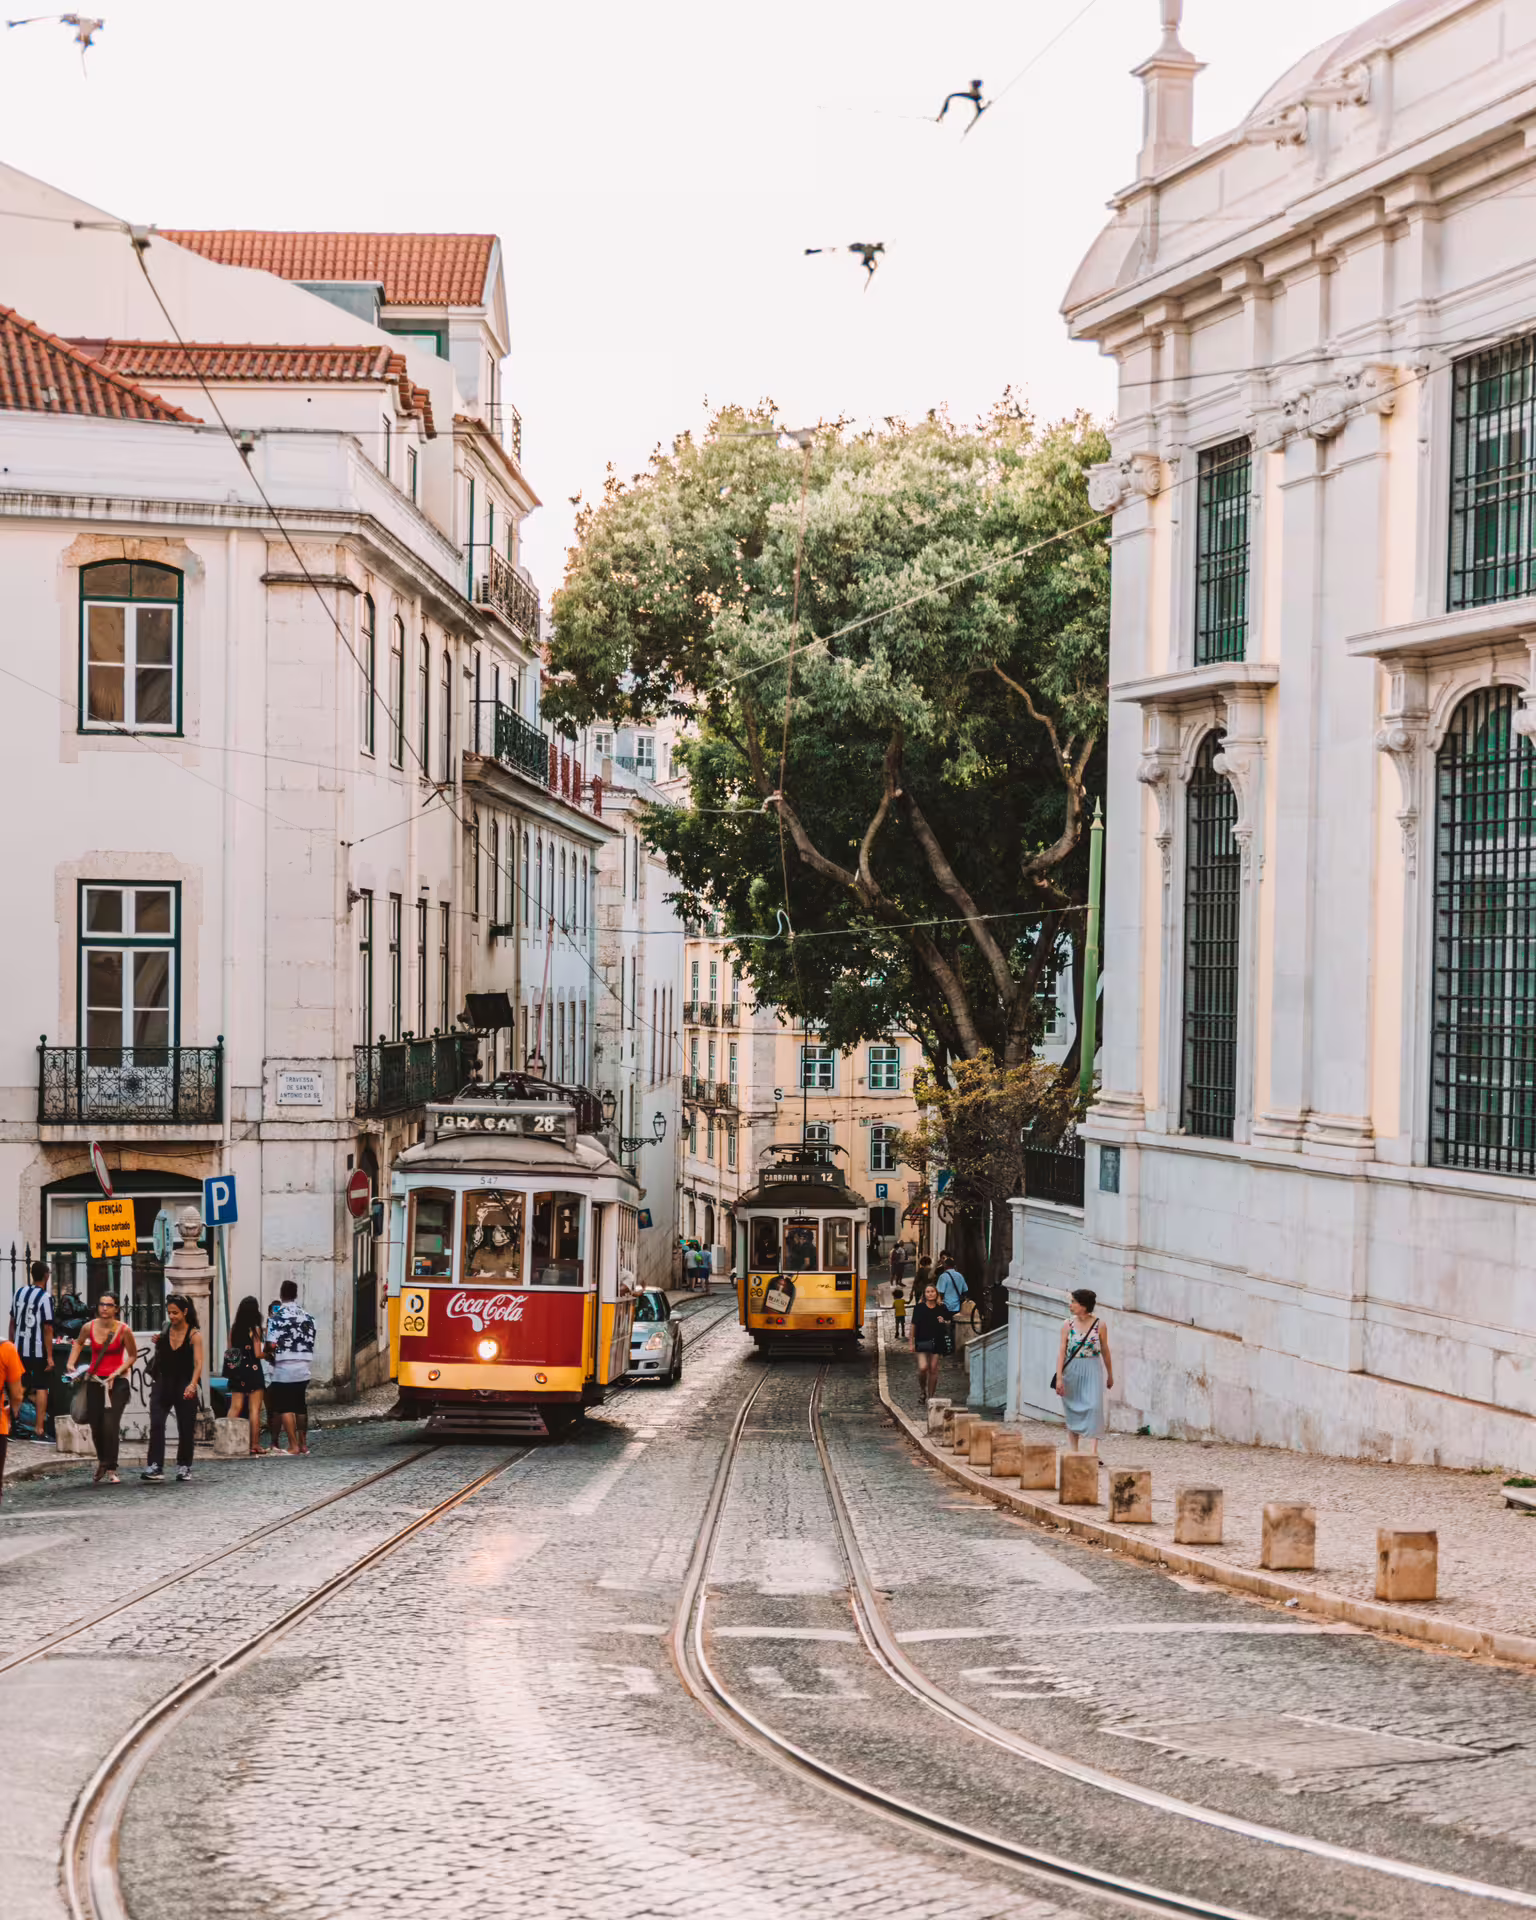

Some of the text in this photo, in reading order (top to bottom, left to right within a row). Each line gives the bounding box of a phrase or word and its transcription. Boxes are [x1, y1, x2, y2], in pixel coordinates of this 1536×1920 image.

[533, 1115, 555, 1132] 28
[480, 1176, 499, 1185] 547
[764, 1174, 798, 1182] CARREIRA
[820, 1172, 833, 1182] 12
[878, 1185, 886, 1197] P
[211, 1181, 230, 1221] P
[98, 1202, 122, 1216] ATENÇÃO
[94, 1221, 130, 1233] Acesso cortado
[446, 1292, 529, 1331] Coca-Cola
